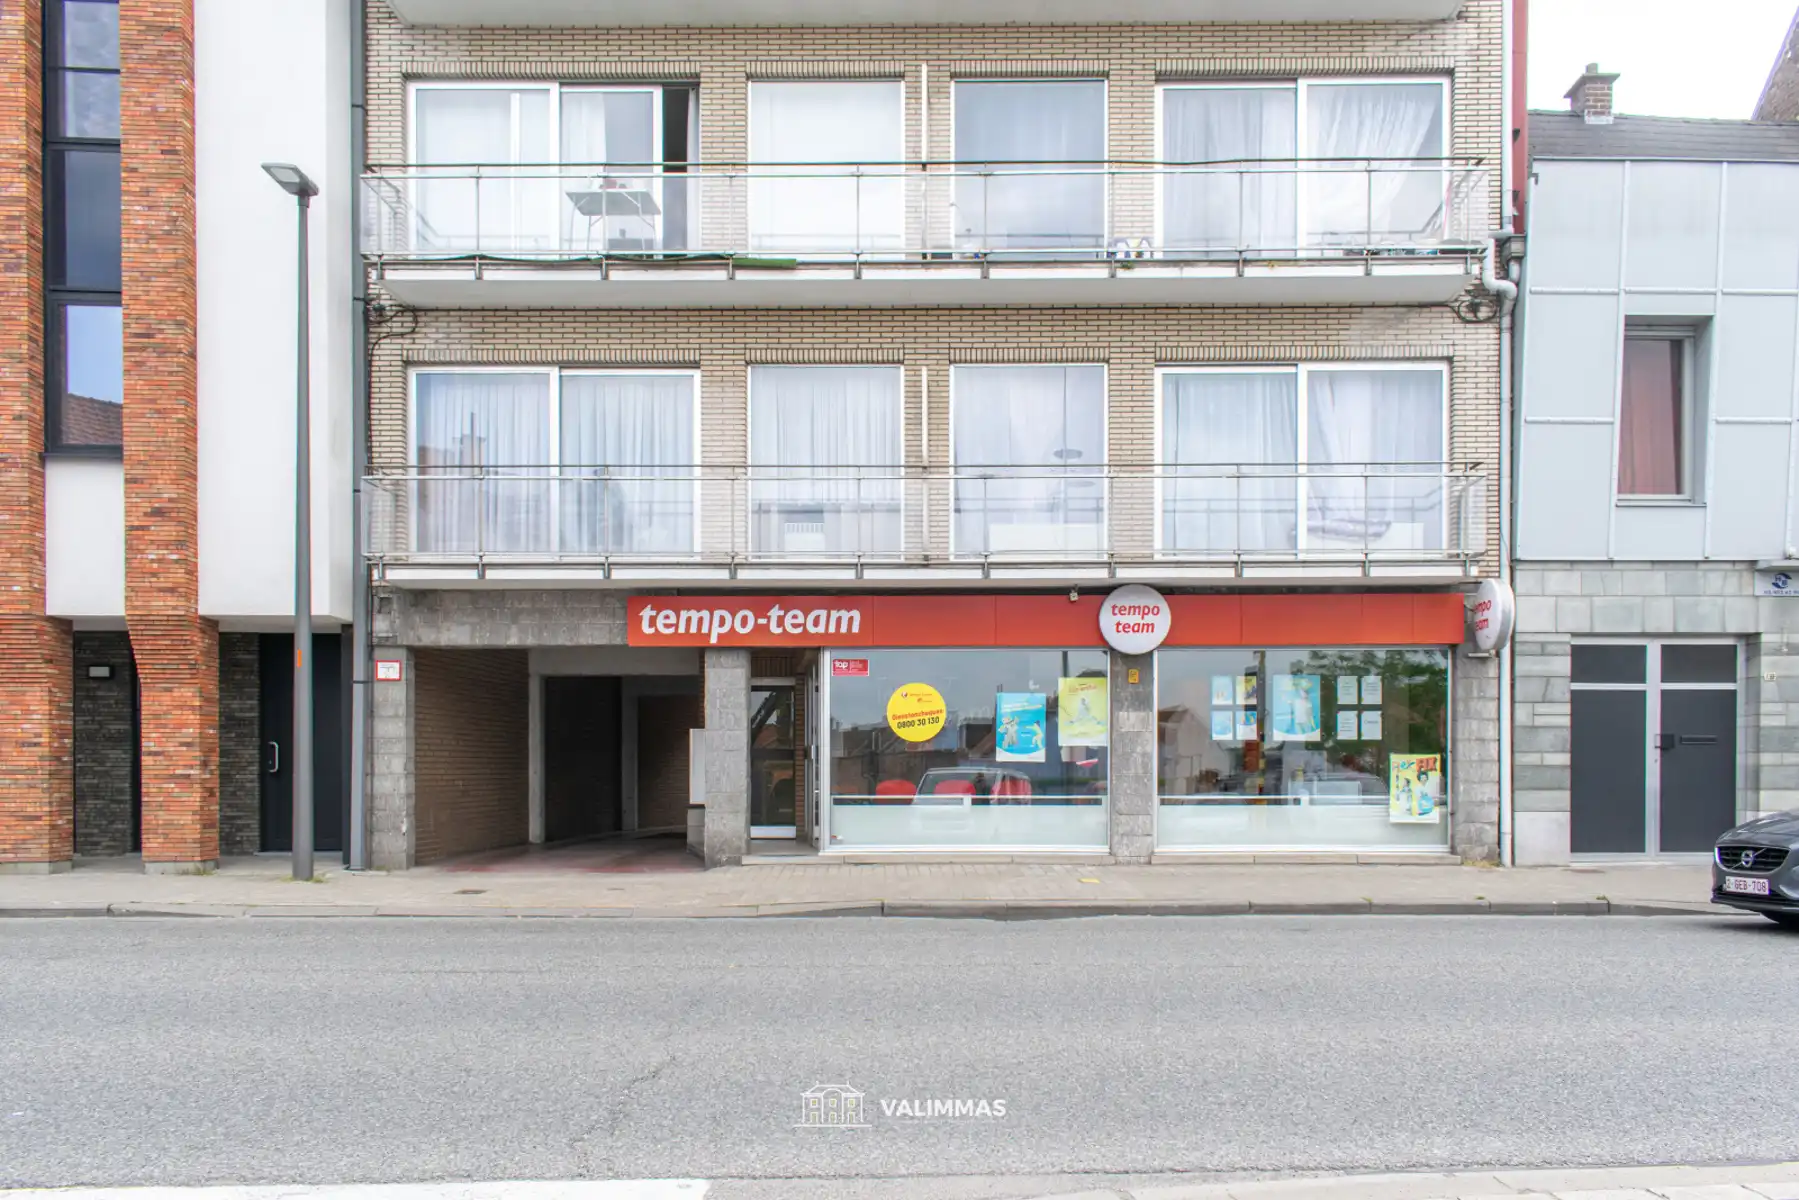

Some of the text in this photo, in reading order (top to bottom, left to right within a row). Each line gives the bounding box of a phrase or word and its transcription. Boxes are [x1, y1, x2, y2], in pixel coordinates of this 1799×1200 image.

[1111, 604, 1160, 620] tempo
[638, 604, 861, 644] tempo-team
[1115, 620, 1155, 633] team
[917, 718, 926, 726] 30
